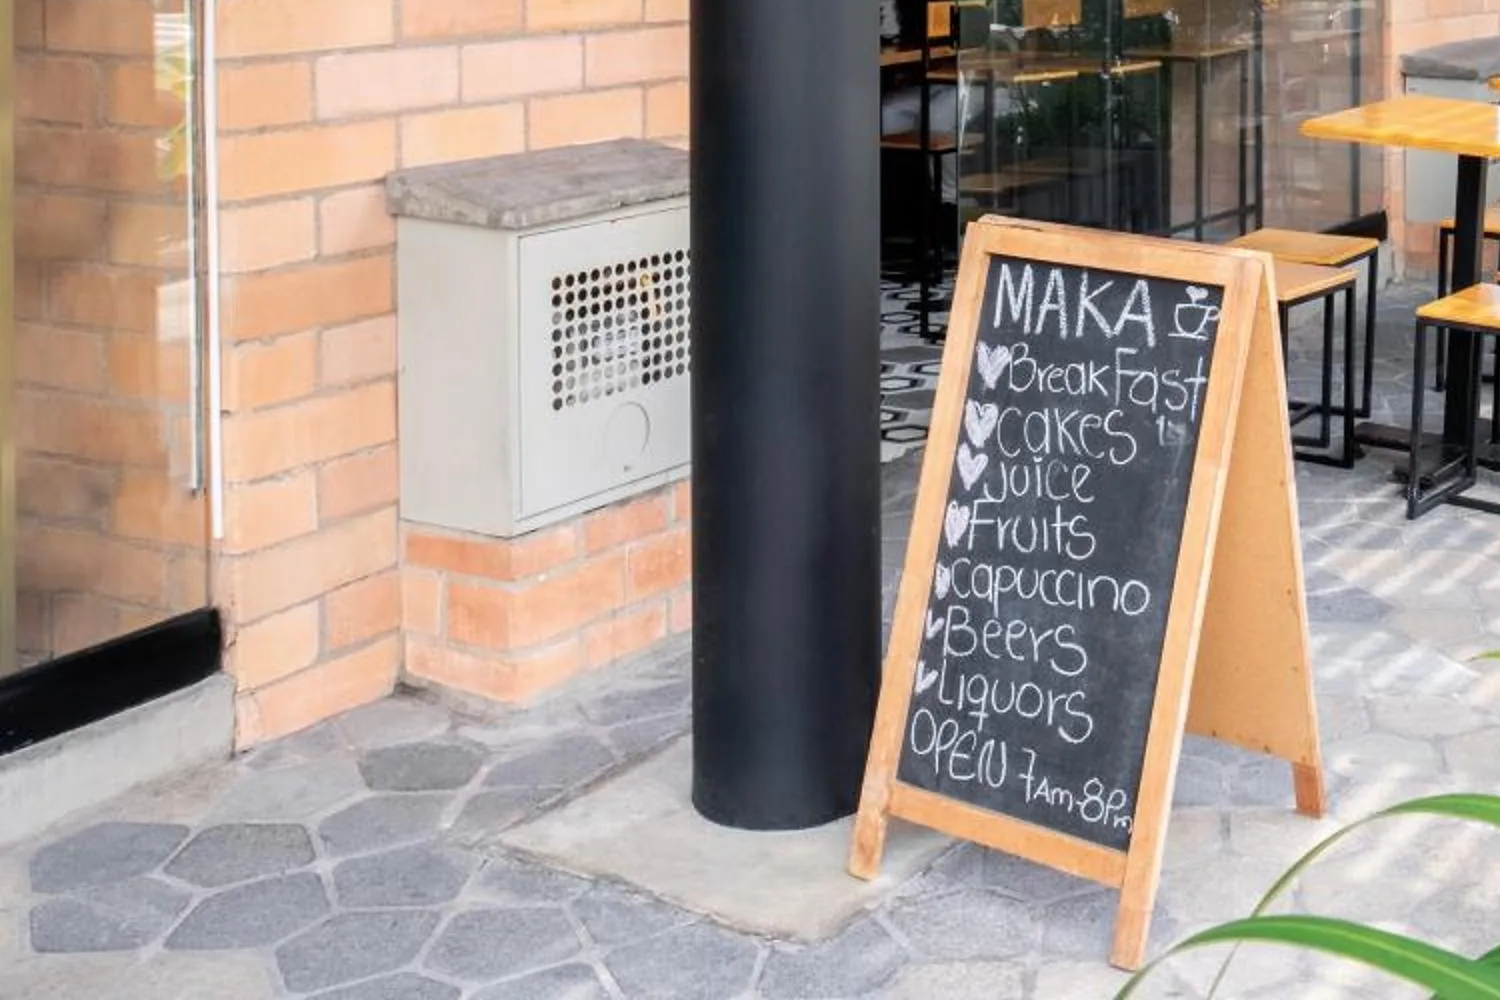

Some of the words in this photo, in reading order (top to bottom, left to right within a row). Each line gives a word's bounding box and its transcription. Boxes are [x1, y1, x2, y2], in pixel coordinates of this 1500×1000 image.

[993, 263, 1156, 347] MAKA
[968, 499, 1097, 560] Fruits
[943, 605, 1088, 676] Beers
[938, 658, 1094, 744] Liquors
[911, 708, 1007, 788] OPEN
